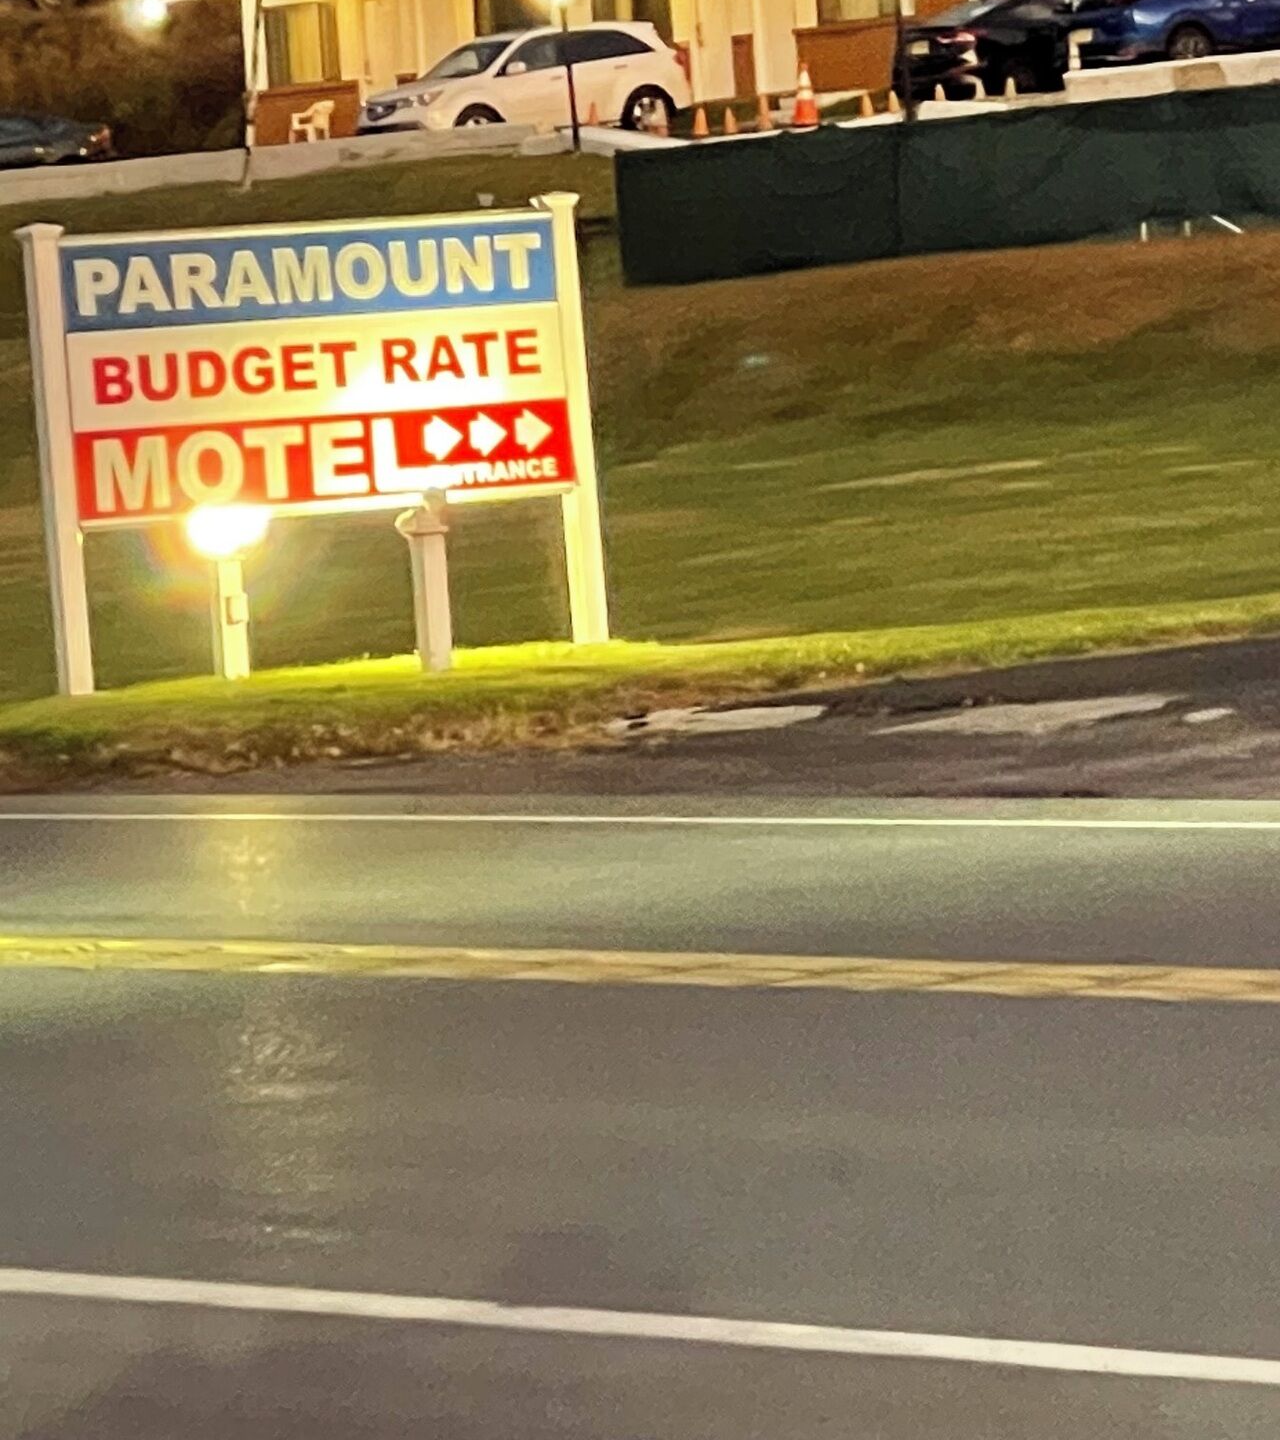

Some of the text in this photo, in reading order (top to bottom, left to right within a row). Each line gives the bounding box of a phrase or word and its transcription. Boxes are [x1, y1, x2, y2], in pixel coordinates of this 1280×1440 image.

[73, 232, 542, 317] PARAMOUNT
[92, 328, 542, 406] BUDGET RATE
[92, 417, 422, 513] MOTEL
[424, 456, 558, 488] TRANCE
